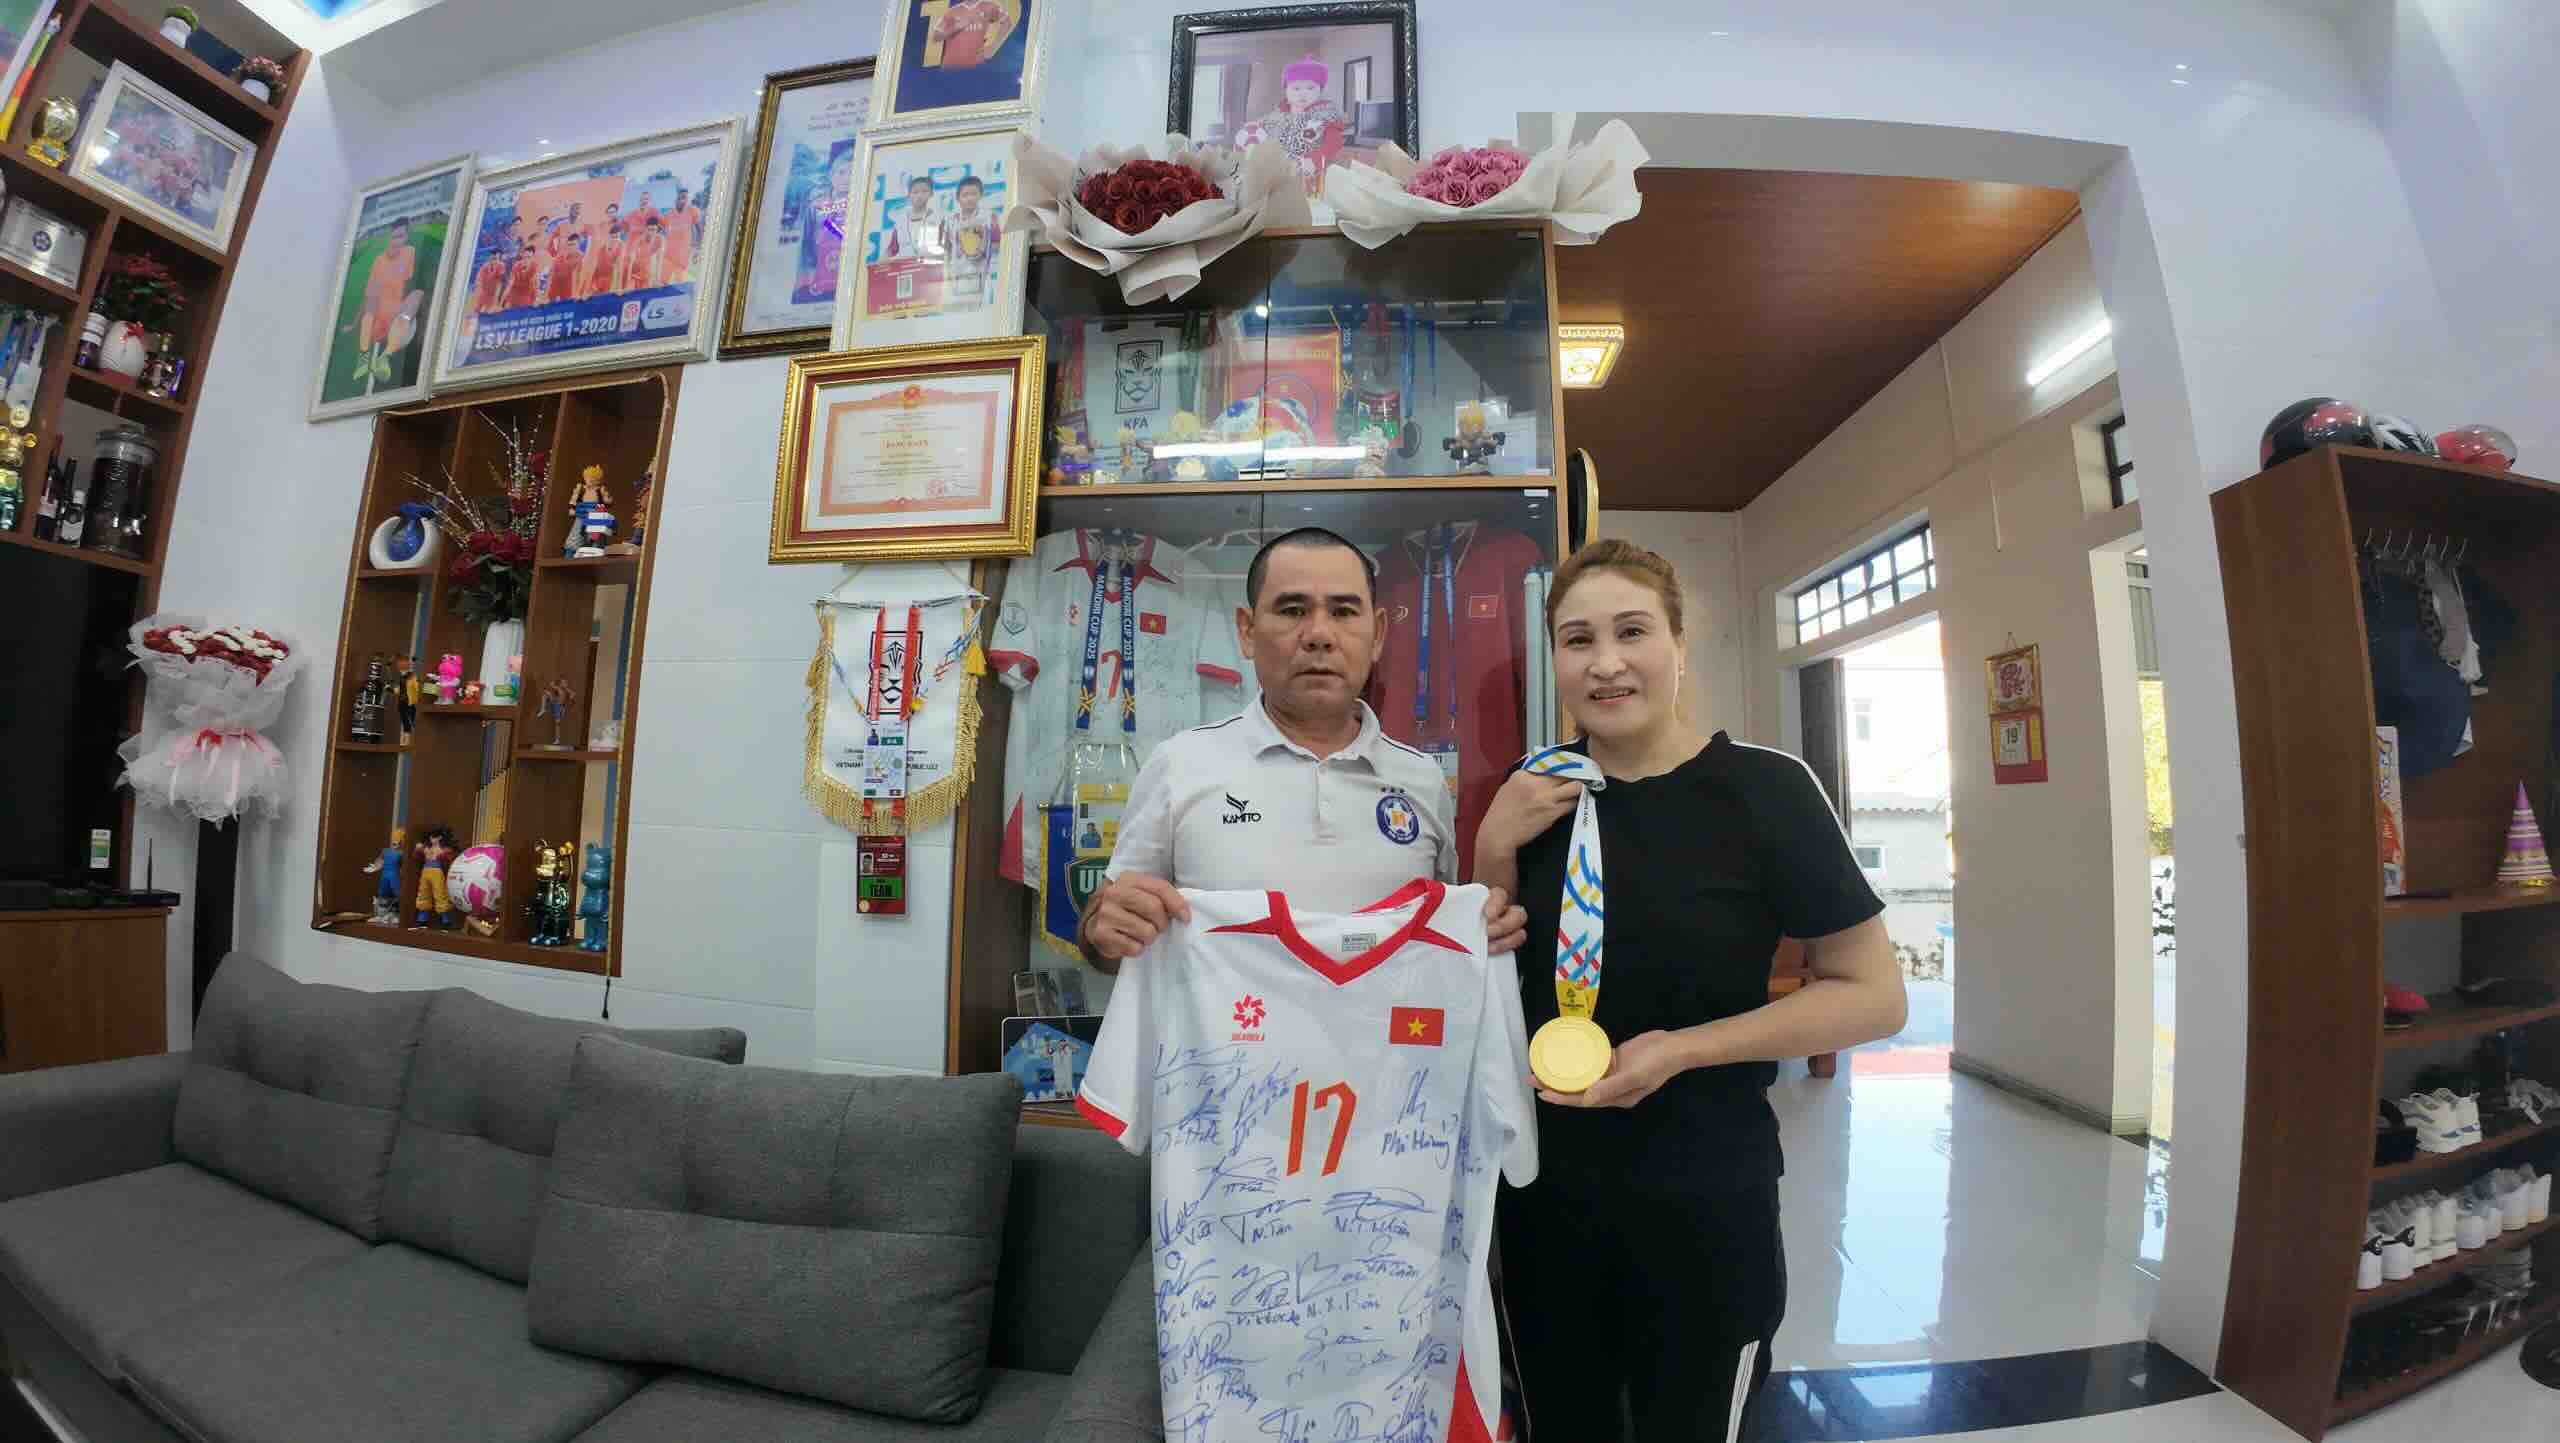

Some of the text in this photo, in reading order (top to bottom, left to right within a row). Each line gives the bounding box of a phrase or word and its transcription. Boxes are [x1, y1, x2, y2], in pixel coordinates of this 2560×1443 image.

[1123, 415, 1149, 430] KFA
[1086, 575, 1105, 661] MANDIRI CUP 2025
[1123, 576, 1132, 662] MANDIRI CUP 2025
[1222, 812, 1262, 824] KAMITO
[1286, 1079, 1358, 1177] 17
